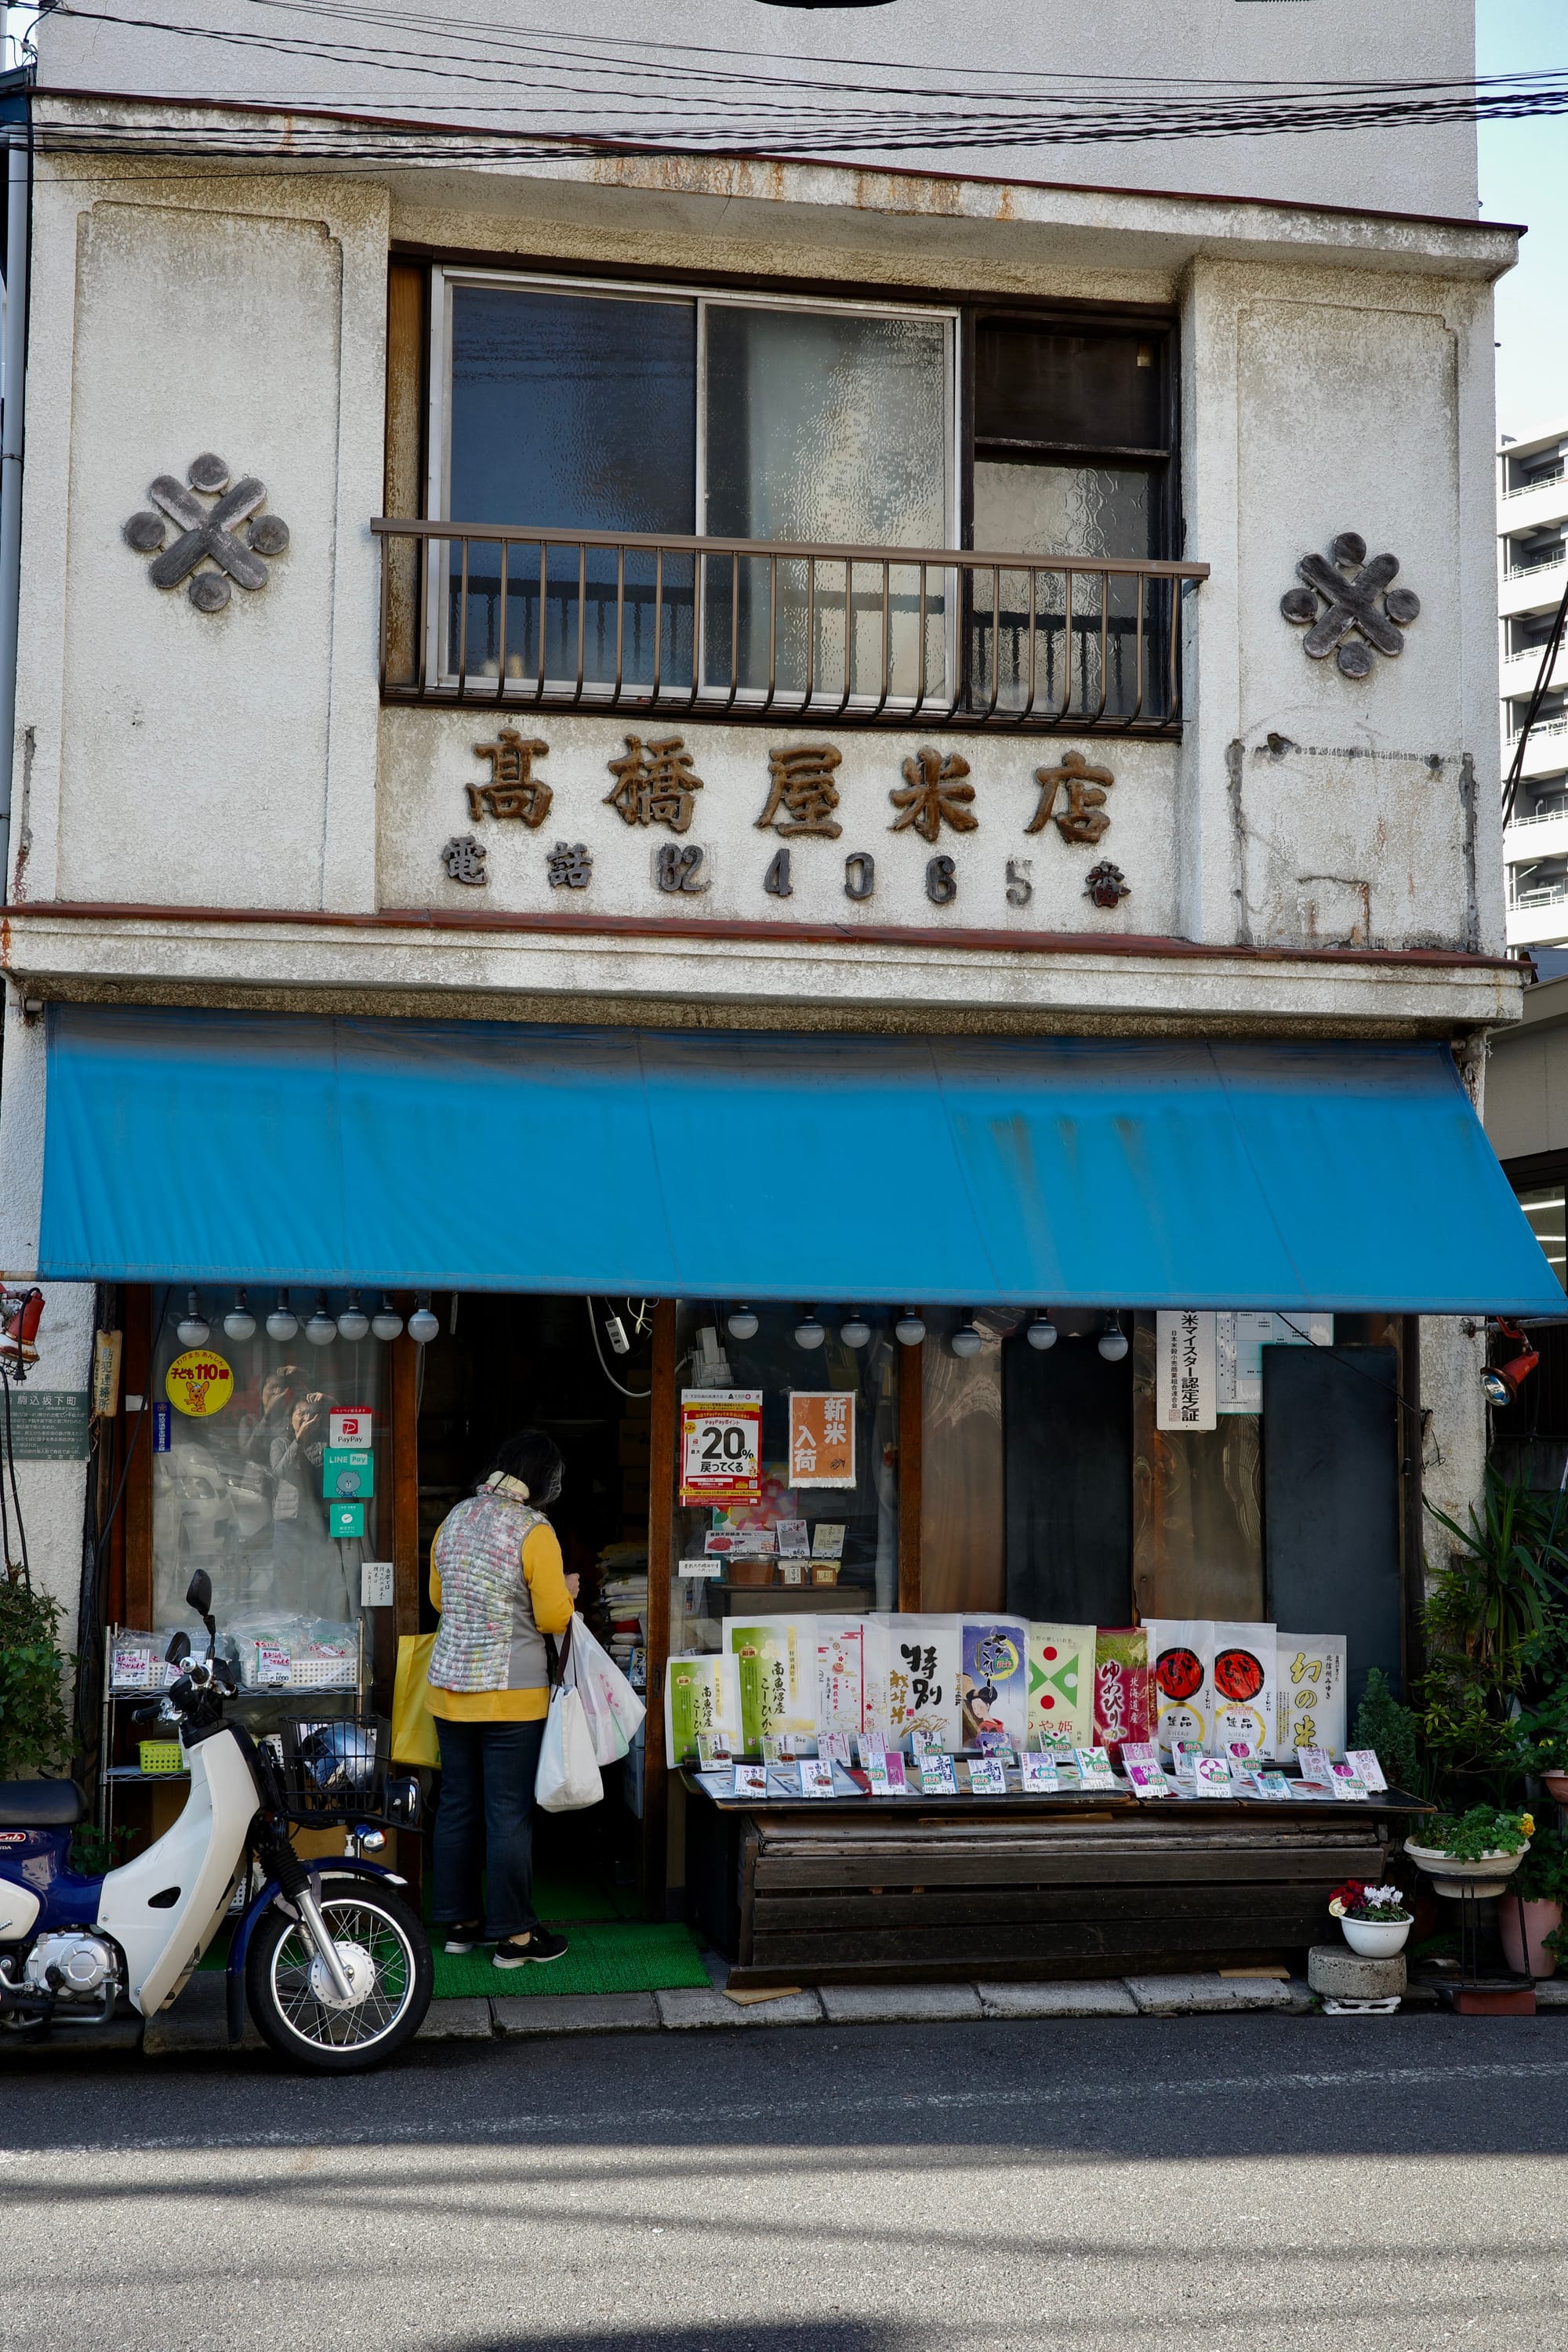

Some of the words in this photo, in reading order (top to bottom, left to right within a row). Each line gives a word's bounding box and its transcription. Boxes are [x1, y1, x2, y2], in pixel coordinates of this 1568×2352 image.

[98, 1348, 114, 1410] 防犯連絡所
[171, 1363, 229, 1380] 子ども110番
[1181, 1311, 1200, 1421] 米マイスター認定之証
[17, 1396, 77, 1406] 駒込坂下町
[824, 1399, 846, 1445] 新米
[700, 1461, 743, 1472] 戻ってくる
[794, 1425, 816, 1472] 入荷
[771, 1661, 786, 1715] 南魚沼産
[900, 1643, 942, 1710] 特別
[1102, 1661, 1127, 1739] ゆめぴりか
[1130, 1676, 1140, 1723] 北海道産
[1324, 1655, 1333, 1700] 北信州みゆき
[702, 1686, 713, 1728] 南魚沼産
[1290, 1653, 1323, 1754] 幻の米
